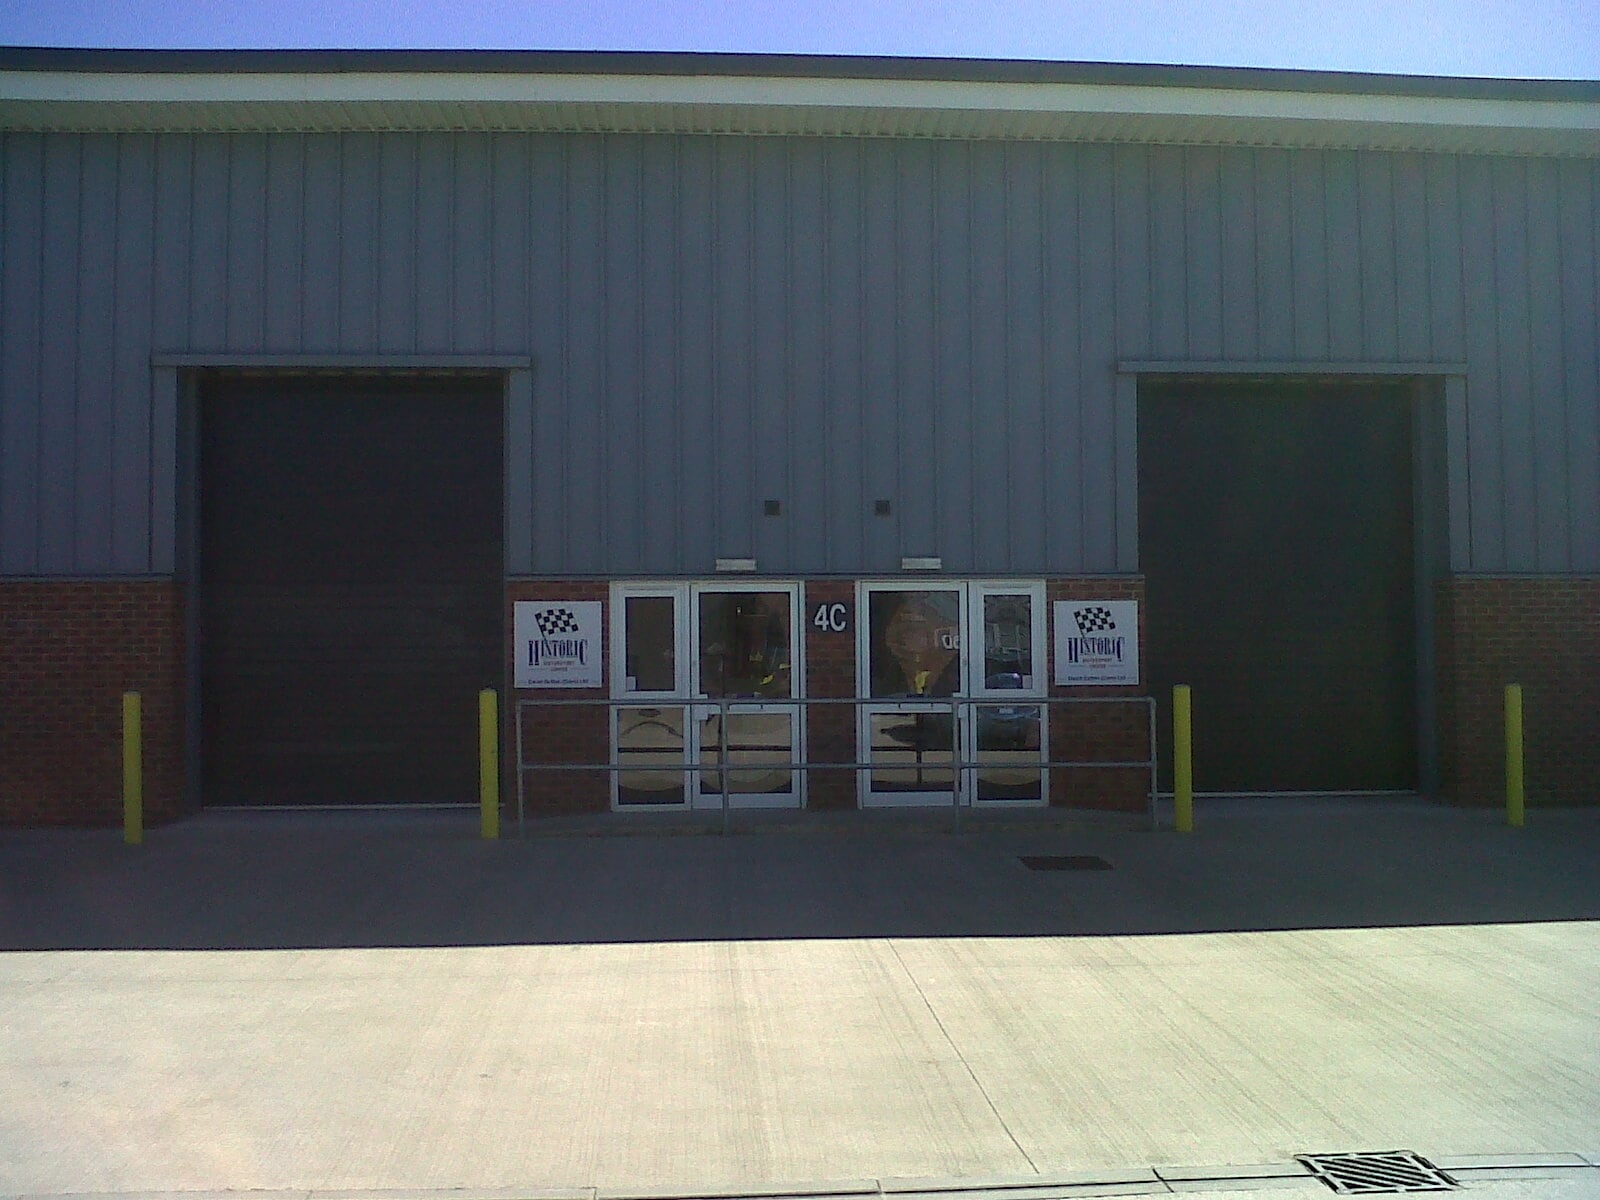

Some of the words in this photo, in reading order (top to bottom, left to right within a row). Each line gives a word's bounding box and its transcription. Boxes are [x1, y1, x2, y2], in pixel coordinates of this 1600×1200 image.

[814, 603, 847, 632] 4C
[528, 638, 588, 666] HISTORIC
[1067, 636, 1126, 664] HISTORIC
